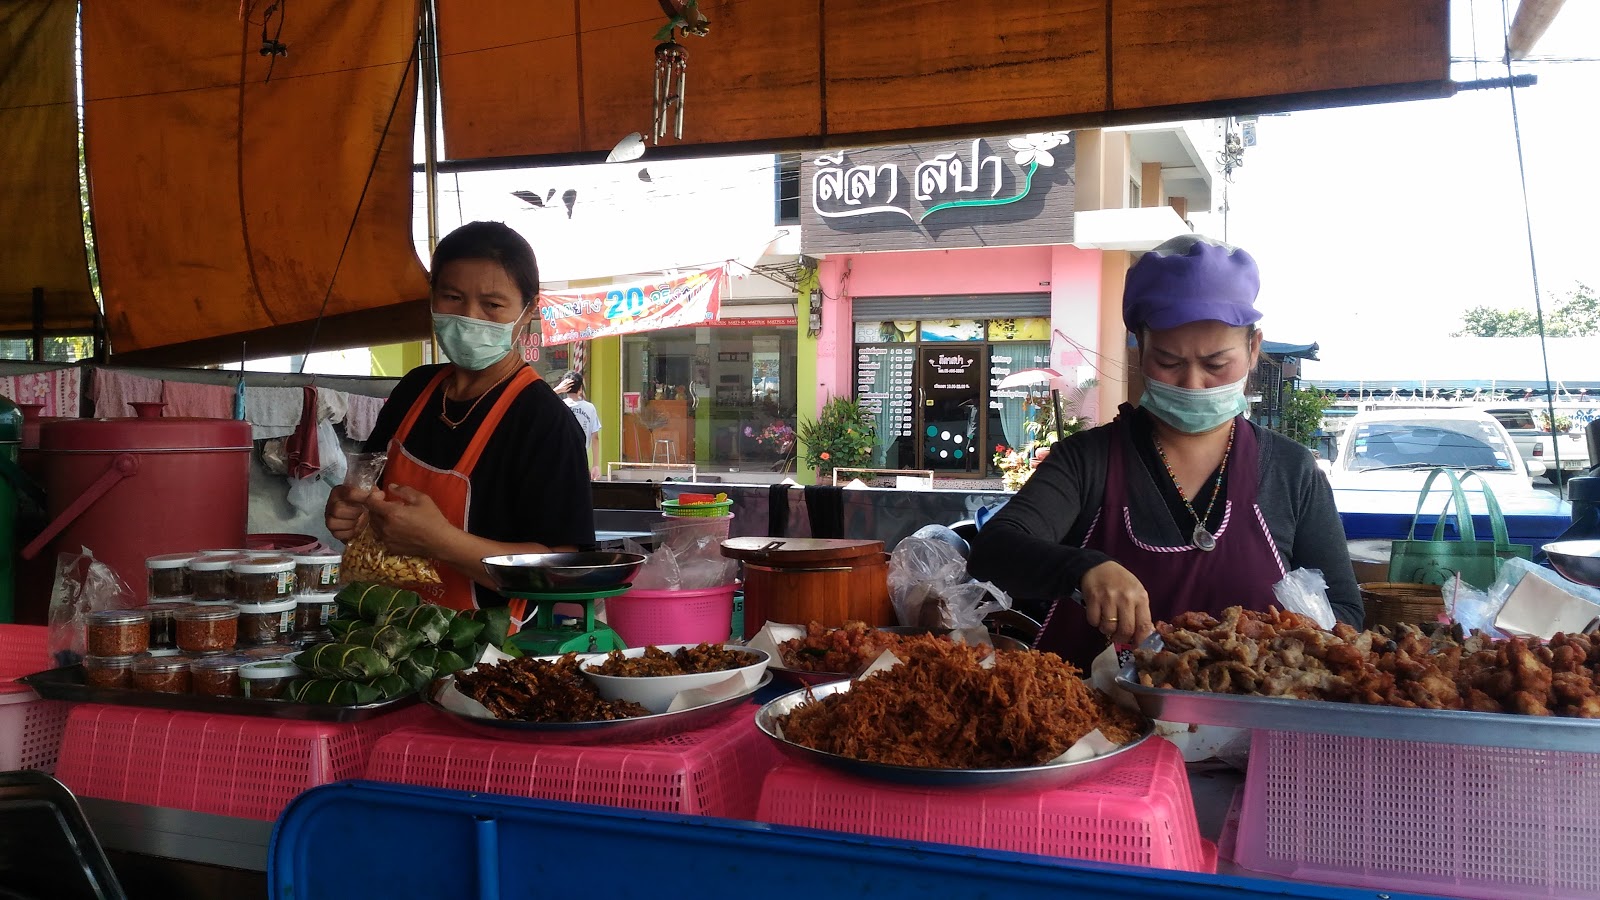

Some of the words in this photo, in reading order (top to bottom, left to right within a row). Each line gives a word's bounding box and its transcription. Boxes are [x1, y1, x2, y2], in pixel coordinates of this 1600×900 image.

[812, 150, 905, 216] ลีลา
[914, 138, 1001, 201] สปา
[606, 287, 644, 319] 20
[524, 347, 540, 362] 80
